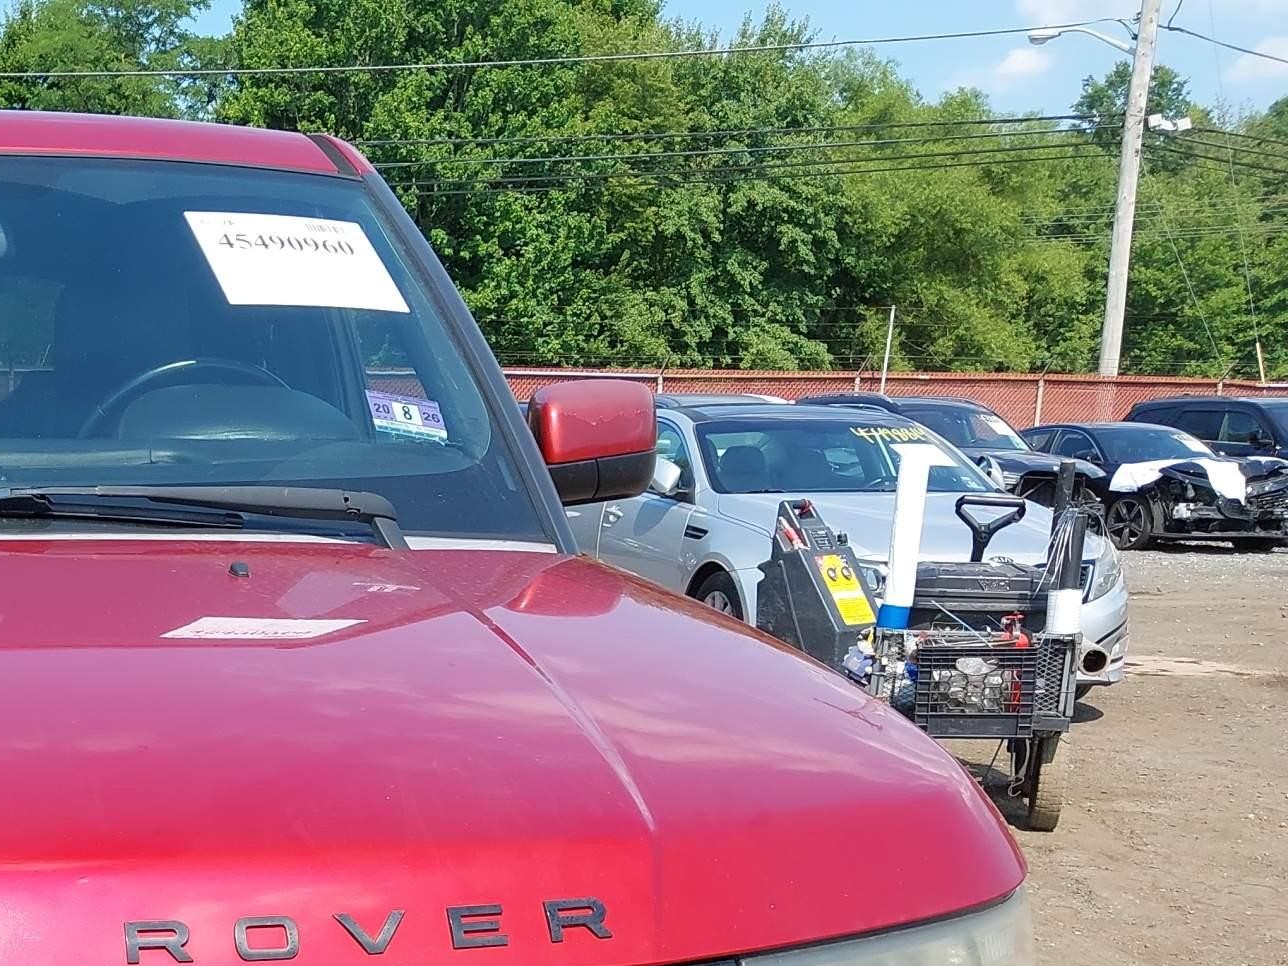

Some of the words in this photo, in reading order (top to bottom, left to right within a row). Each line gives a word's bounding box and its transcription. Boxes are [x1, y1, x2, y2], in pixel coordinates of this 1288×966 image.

[219, 233, 354, 255] 45490960
[373, 403, 391, 415] 20
[401, 405, 413, 421] 8
[422, 412, 441, 424] 26
[125, 898, 613, 965] ROVER
